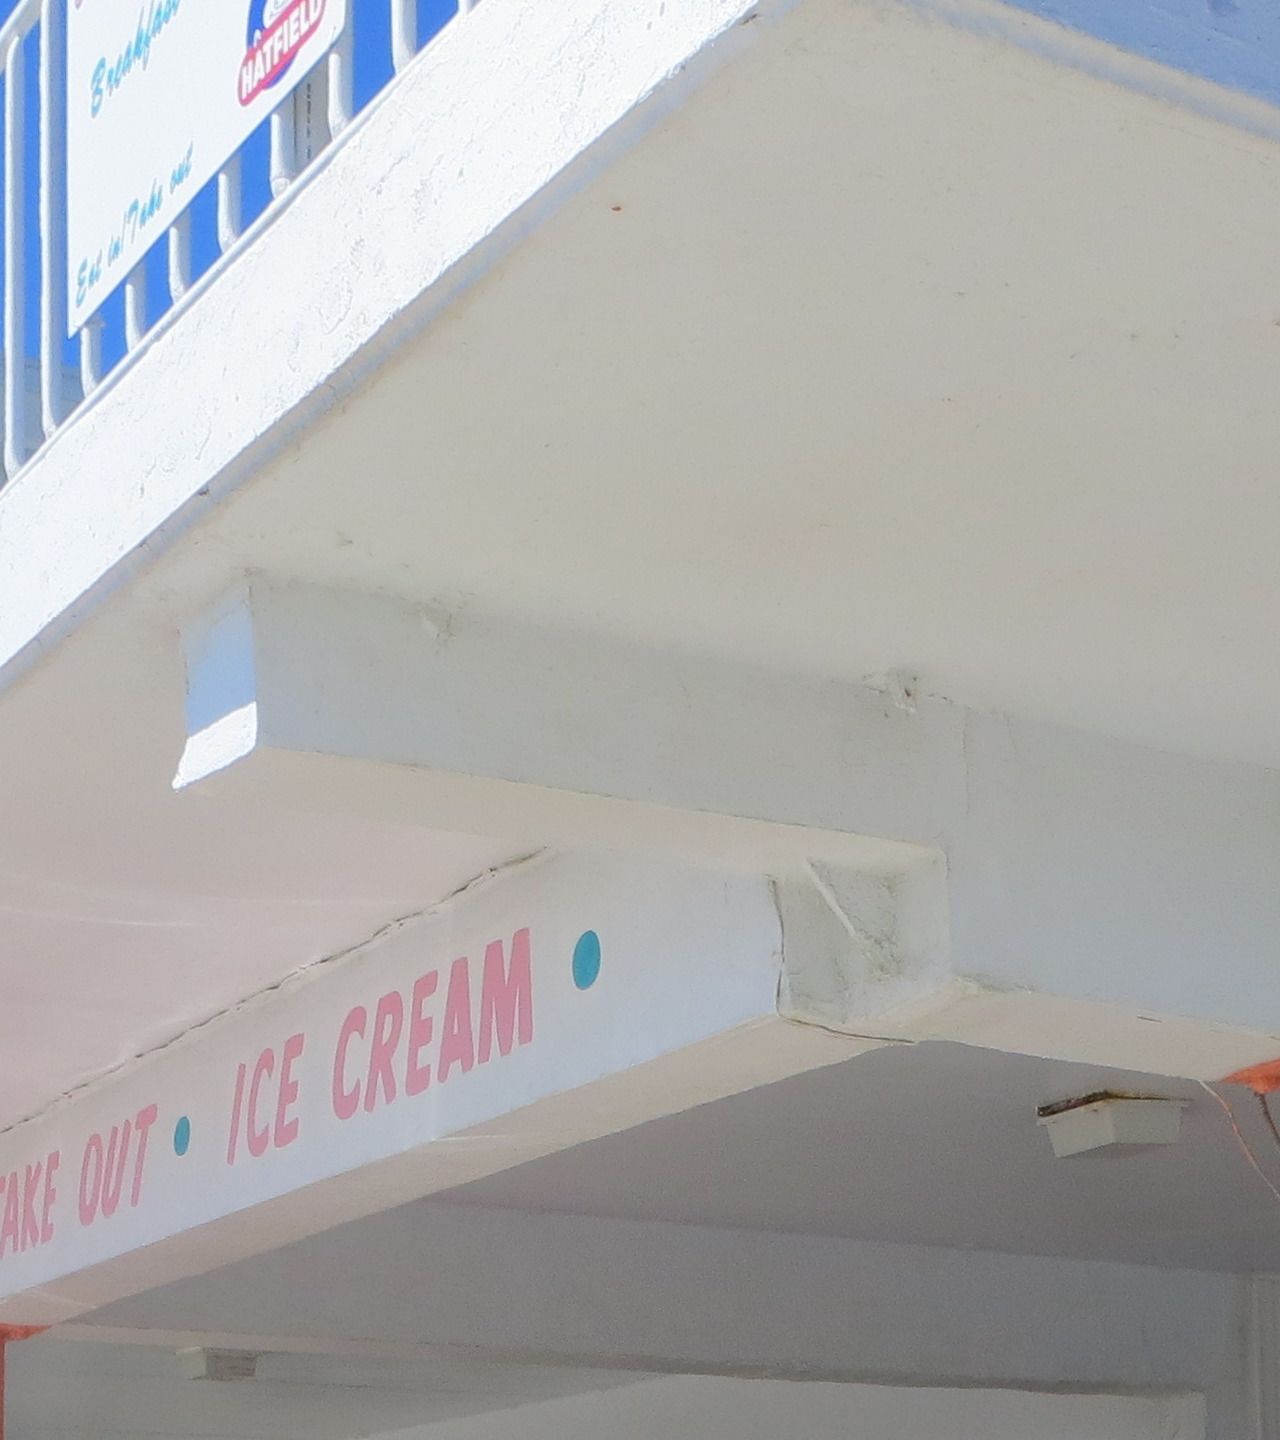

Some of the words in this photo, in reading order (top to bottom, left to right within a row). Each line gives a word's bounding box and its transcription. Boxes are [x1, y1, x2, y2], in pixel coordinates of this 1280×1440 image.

[78, 1103, 158, 1228] OUT
[226, 1031, 305, 1167] ICE
[331, 927, 535, 1121] CREAM
